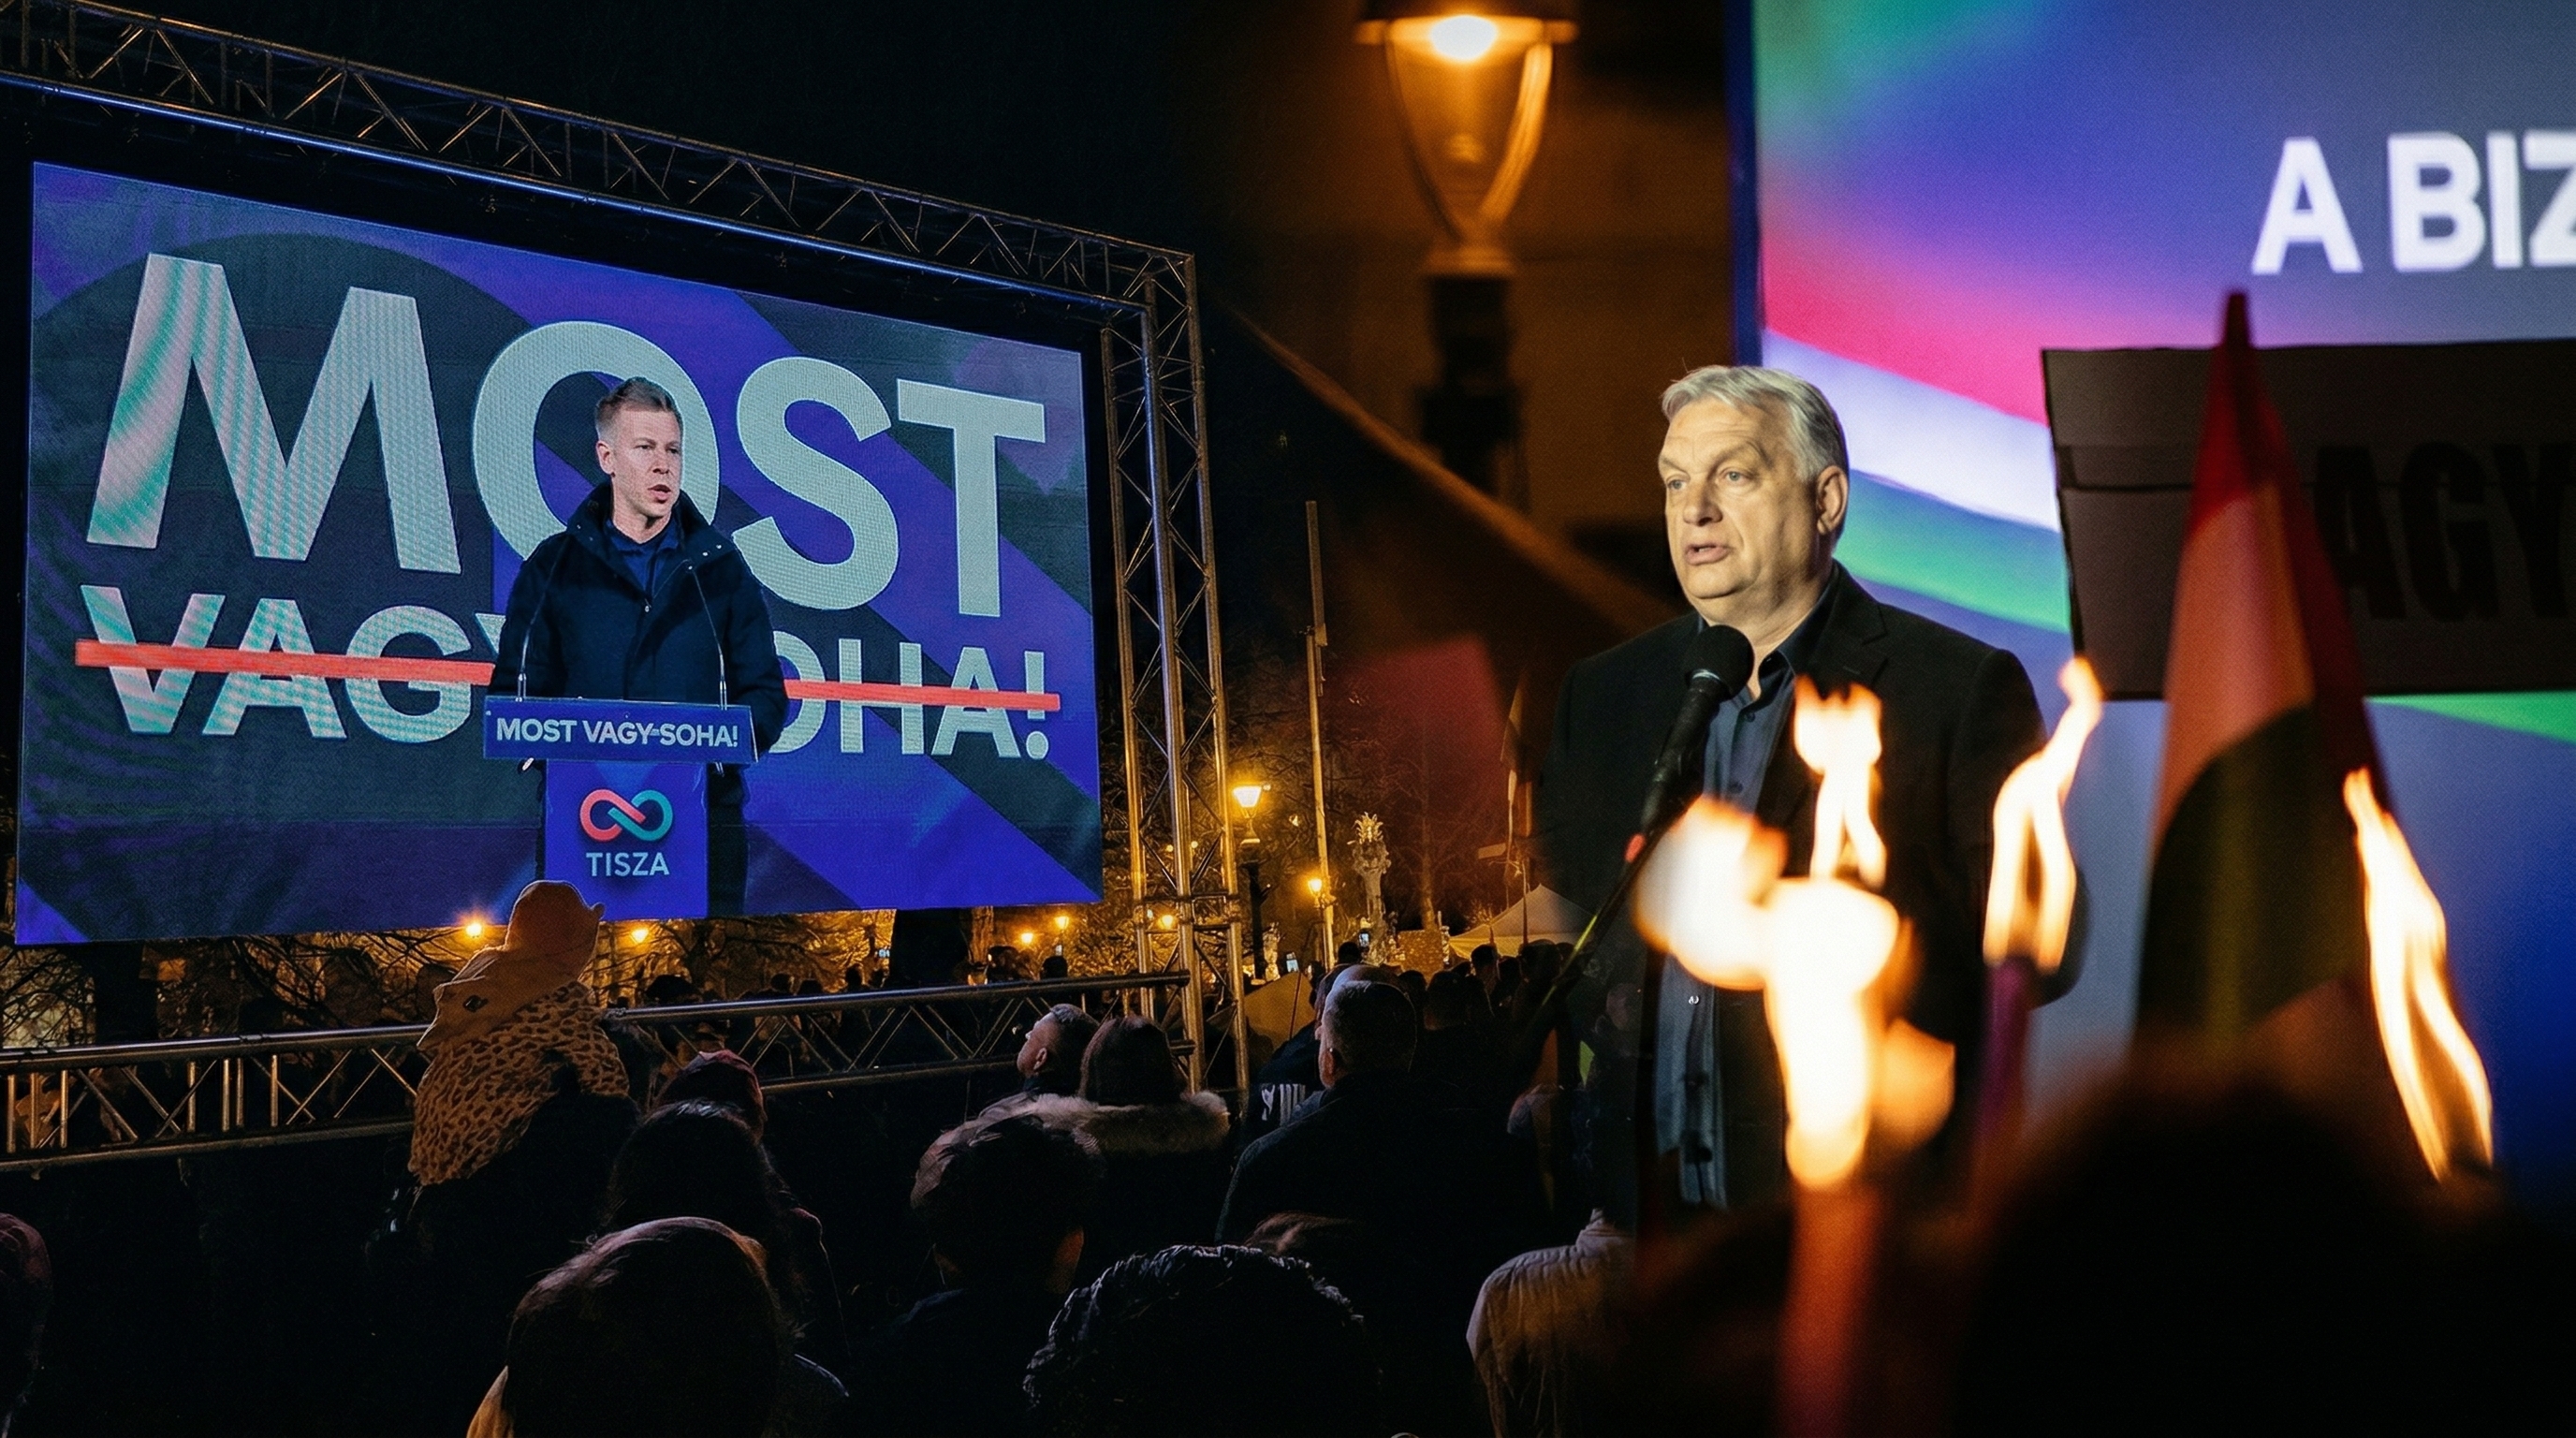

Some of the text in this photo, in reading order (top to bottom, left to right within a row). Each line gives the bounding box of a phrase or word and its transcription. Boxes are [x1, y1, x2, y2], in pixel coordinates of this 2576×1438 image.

[2251, 135, 2364, 275] A
[87, 252, 1046, 618] MOST
[80, 584, 506, 743] VAG
[496, 717, 578, 743] MOST
[586, 852, 670, 877] TISZA
